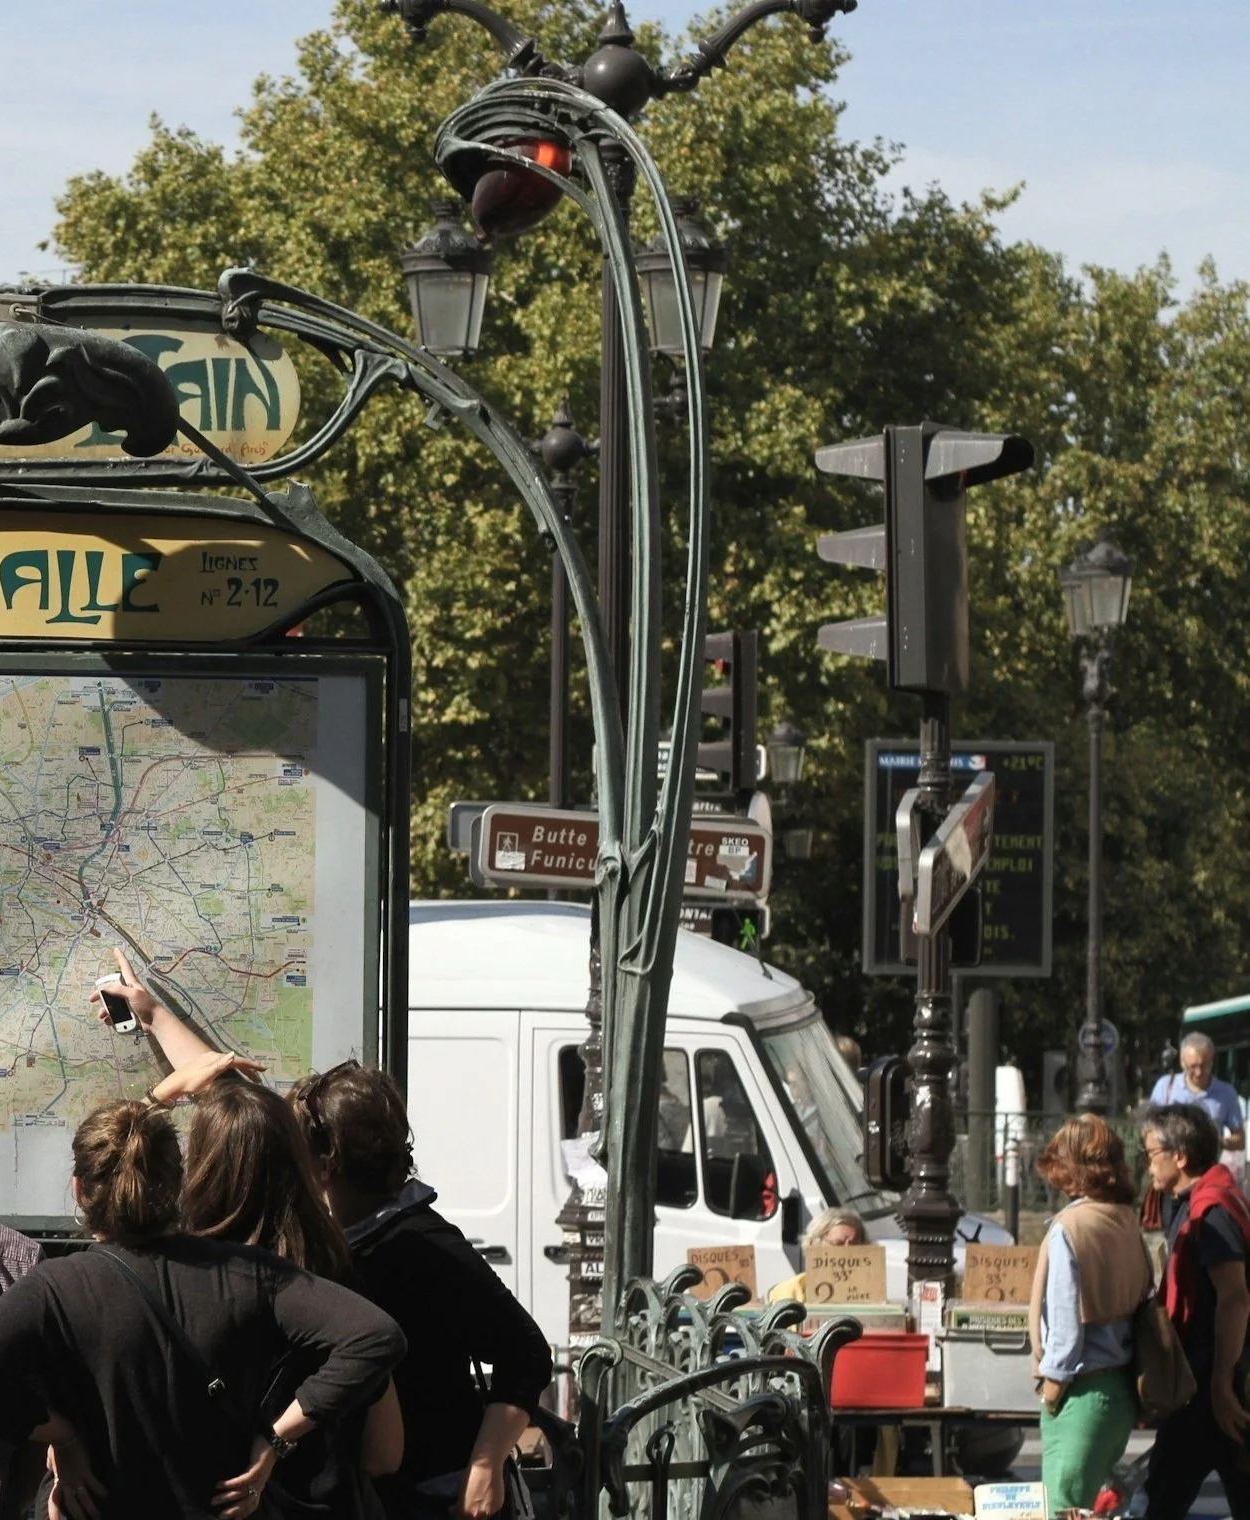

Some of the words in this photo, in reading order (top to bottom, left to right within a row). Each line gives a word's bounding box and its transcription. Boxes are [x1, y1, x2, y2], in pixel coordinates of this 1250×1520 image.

[200, 551, 258, 573] LIGNES
[531, 825, 587, 847] Butte
[530, 852, 596, 871] Funicu
